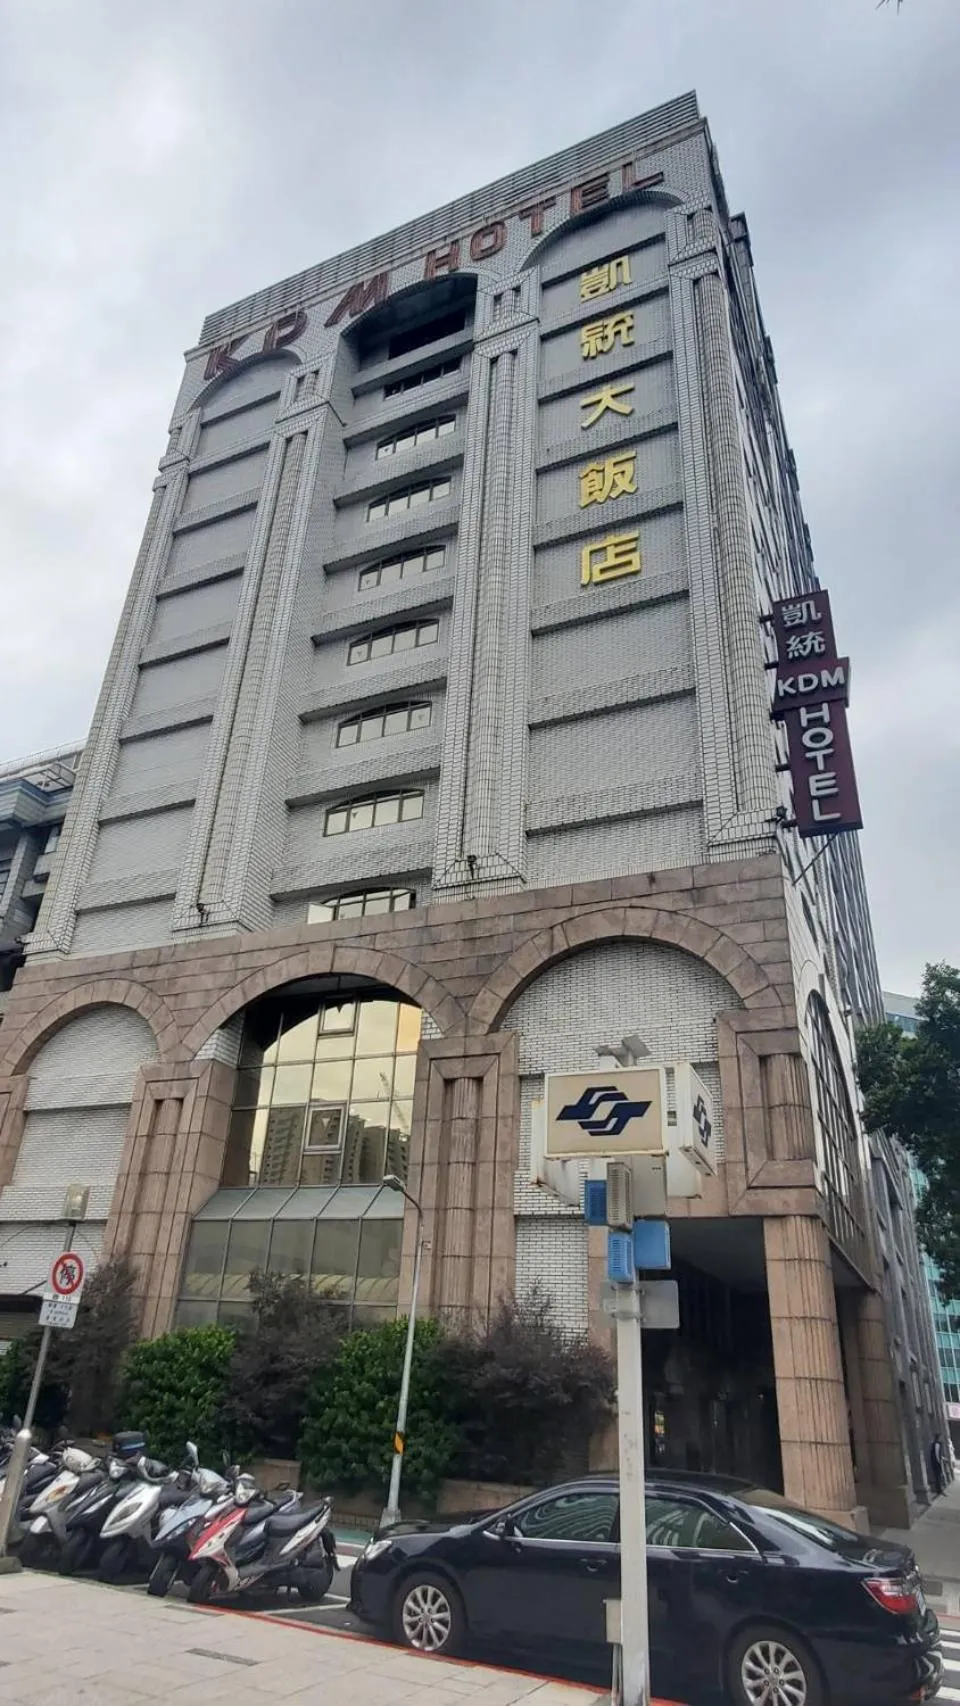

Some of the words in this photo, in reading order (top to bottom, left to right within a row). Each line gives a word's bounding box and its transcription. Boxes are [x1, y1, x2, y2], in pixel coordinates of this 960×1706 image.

[204, 272, 389, 380] KDM
[423, 161, 665, 281] HOTEL
[579, 255, 641, 587] 凱統大飯店
[777, 666, 845, 697] KDM
[781, 600, 826, 660] 凱統
[800, 702, 841, 822] HOTEL
